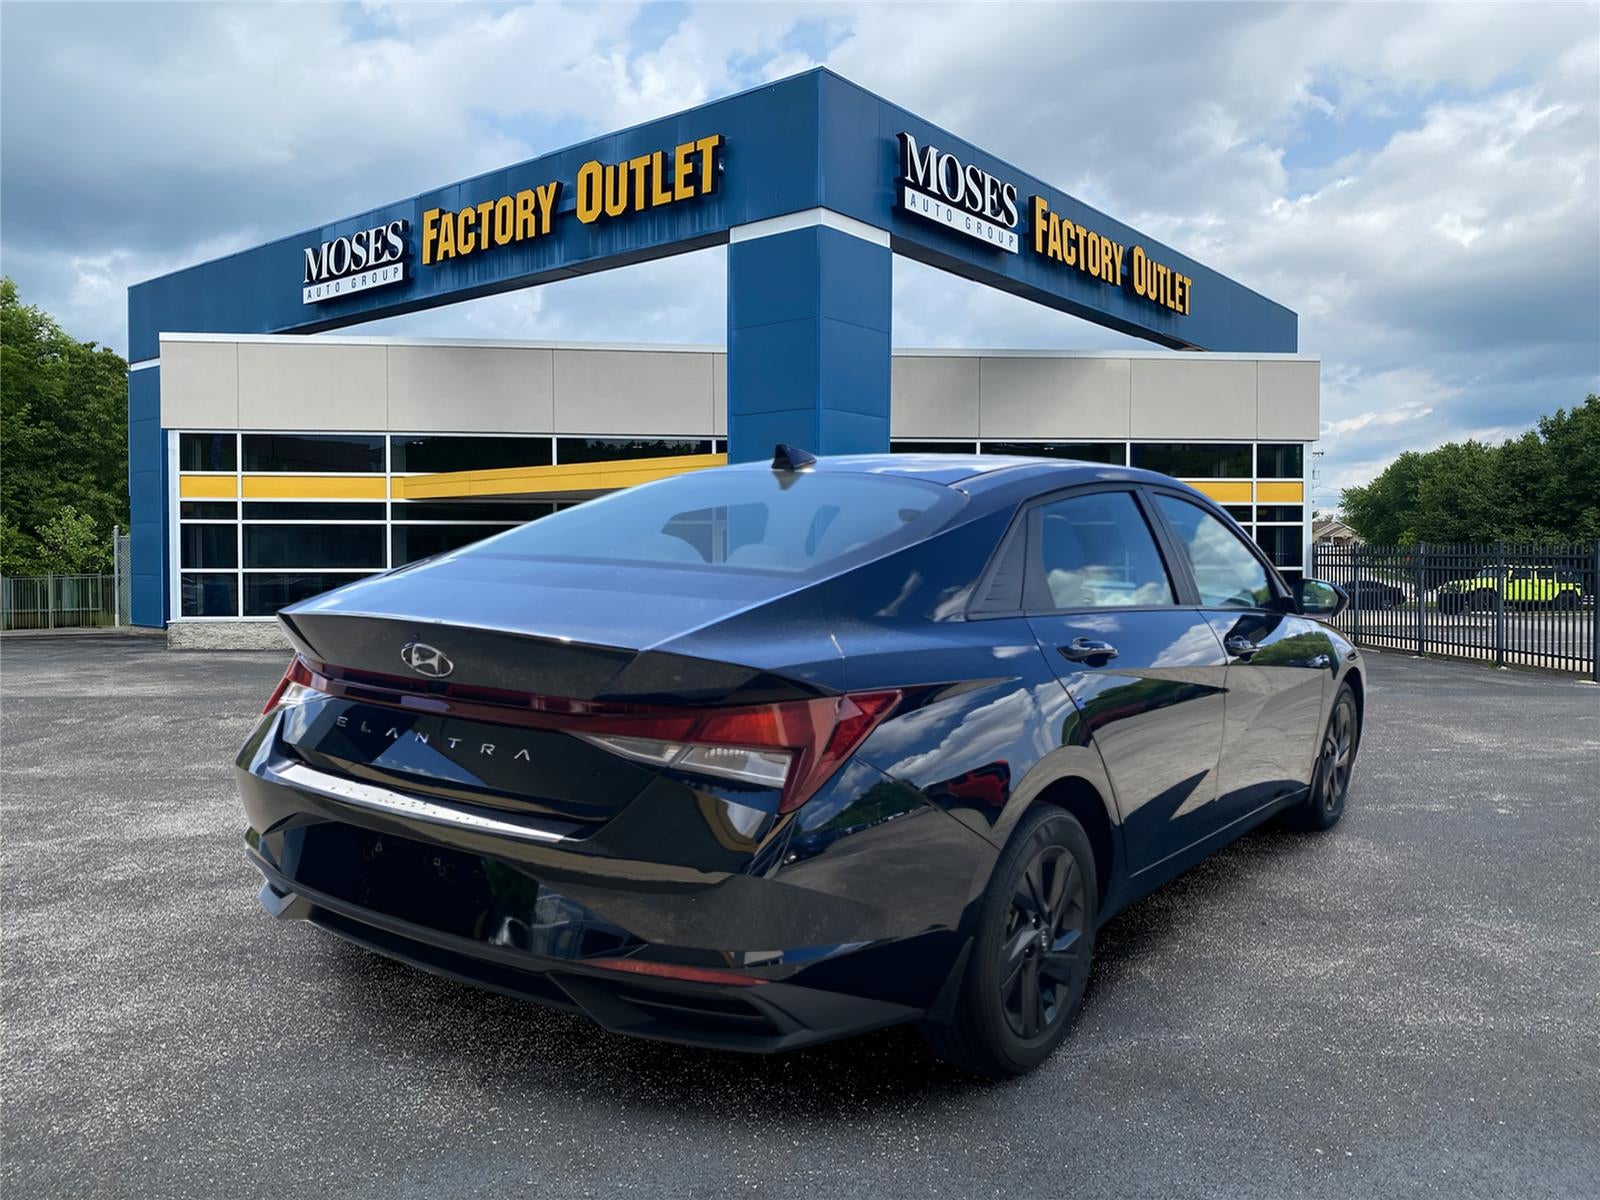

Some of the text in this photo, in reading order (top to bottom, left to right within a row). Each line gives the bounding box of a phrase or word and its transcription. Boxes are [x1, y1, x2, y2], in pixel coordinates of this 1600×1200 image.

[421, 134, 721, 265] FACTORY OUTLET
[903, 132, 1019, 228] MOSES
[303, 220, 404, 284] MOSES
[909, 192, 1015, 248] AUTO GROUP
[306, 266, 401, 301] AUTO GROUP
[1034, 195, 1192, 316] FACTORY OUTLET
[335, 715, 531, 762] ELANTRA
